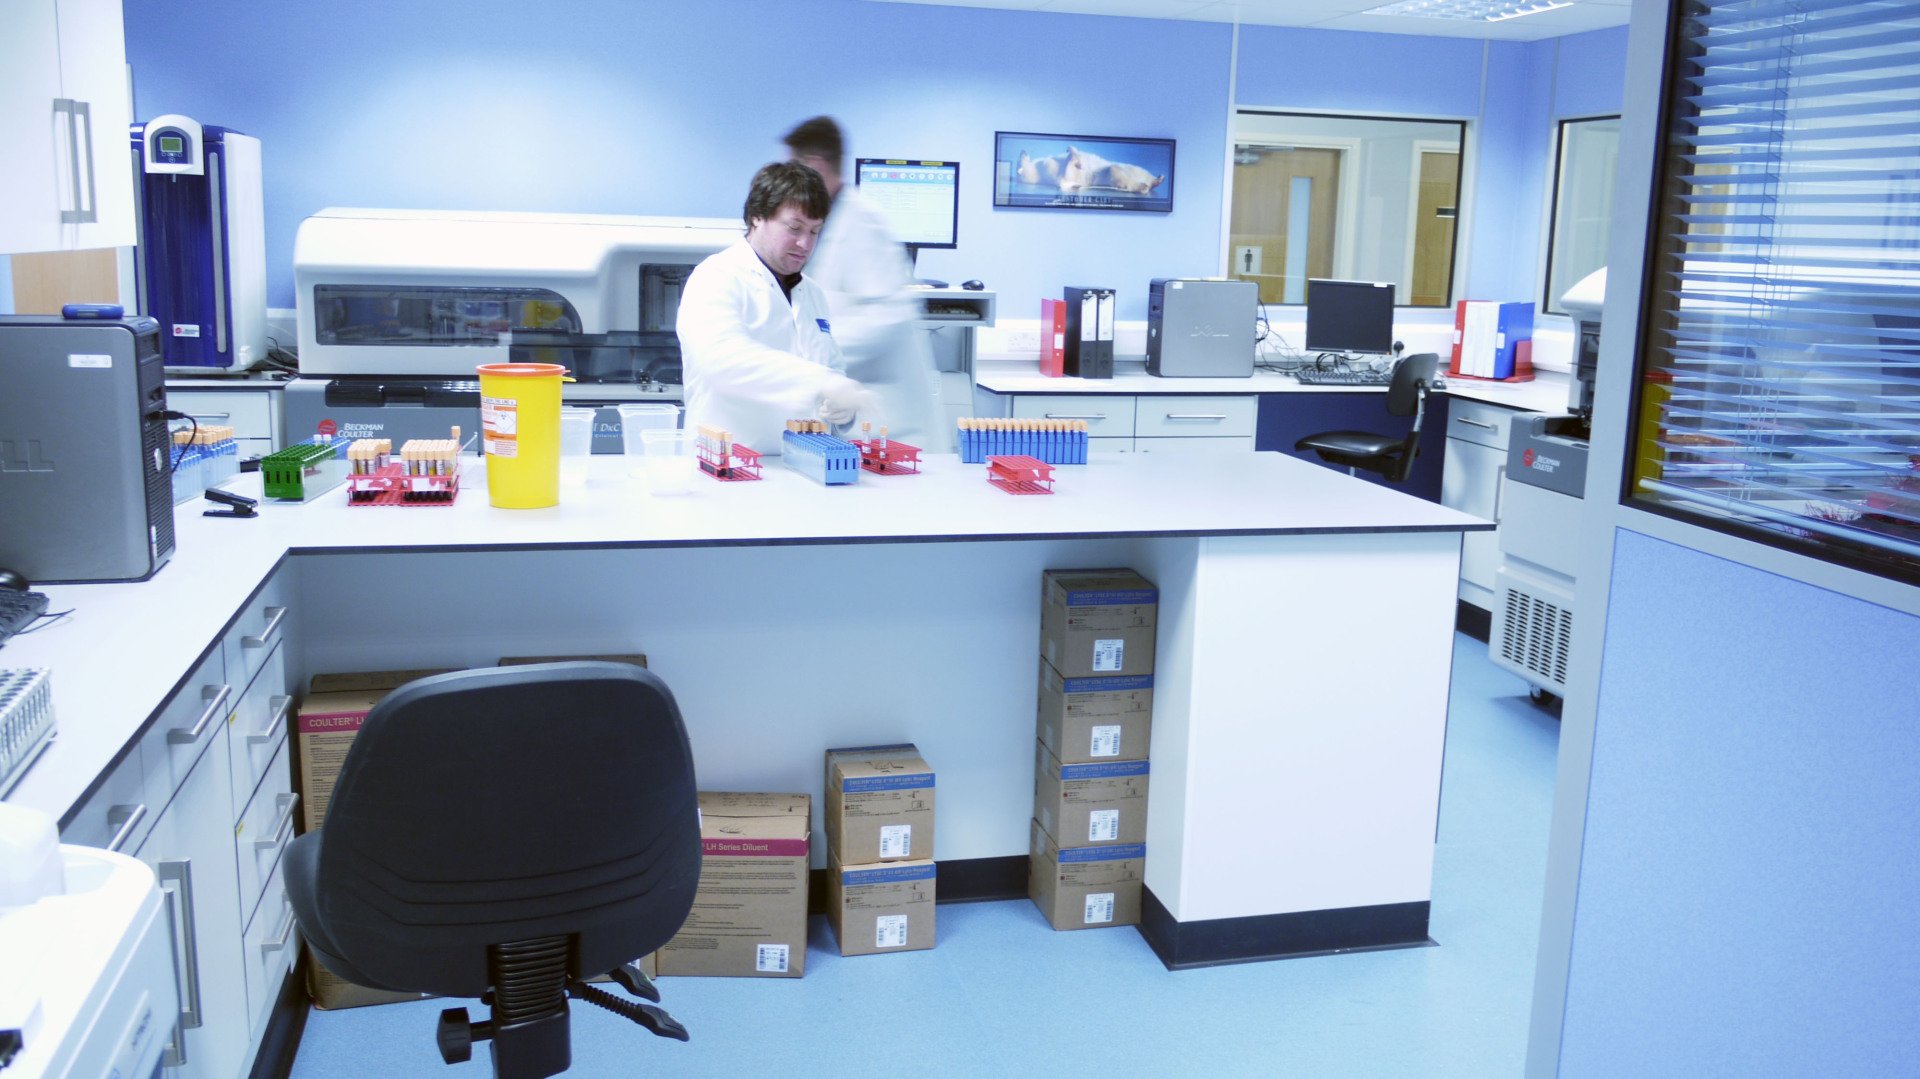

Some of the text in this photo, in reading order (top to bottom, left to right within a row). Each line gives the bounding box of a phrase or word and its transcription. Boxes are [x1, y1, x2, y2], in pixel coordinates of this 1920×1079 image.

[344, 423, 384, 431] BECKMAN
[337, 430, 374, 438] COULTER
[1537, 455, 1561, 467] BECKMAN
[1533, 461, 1554, 473] COULTER
[706, 843, 717, 851] LH
